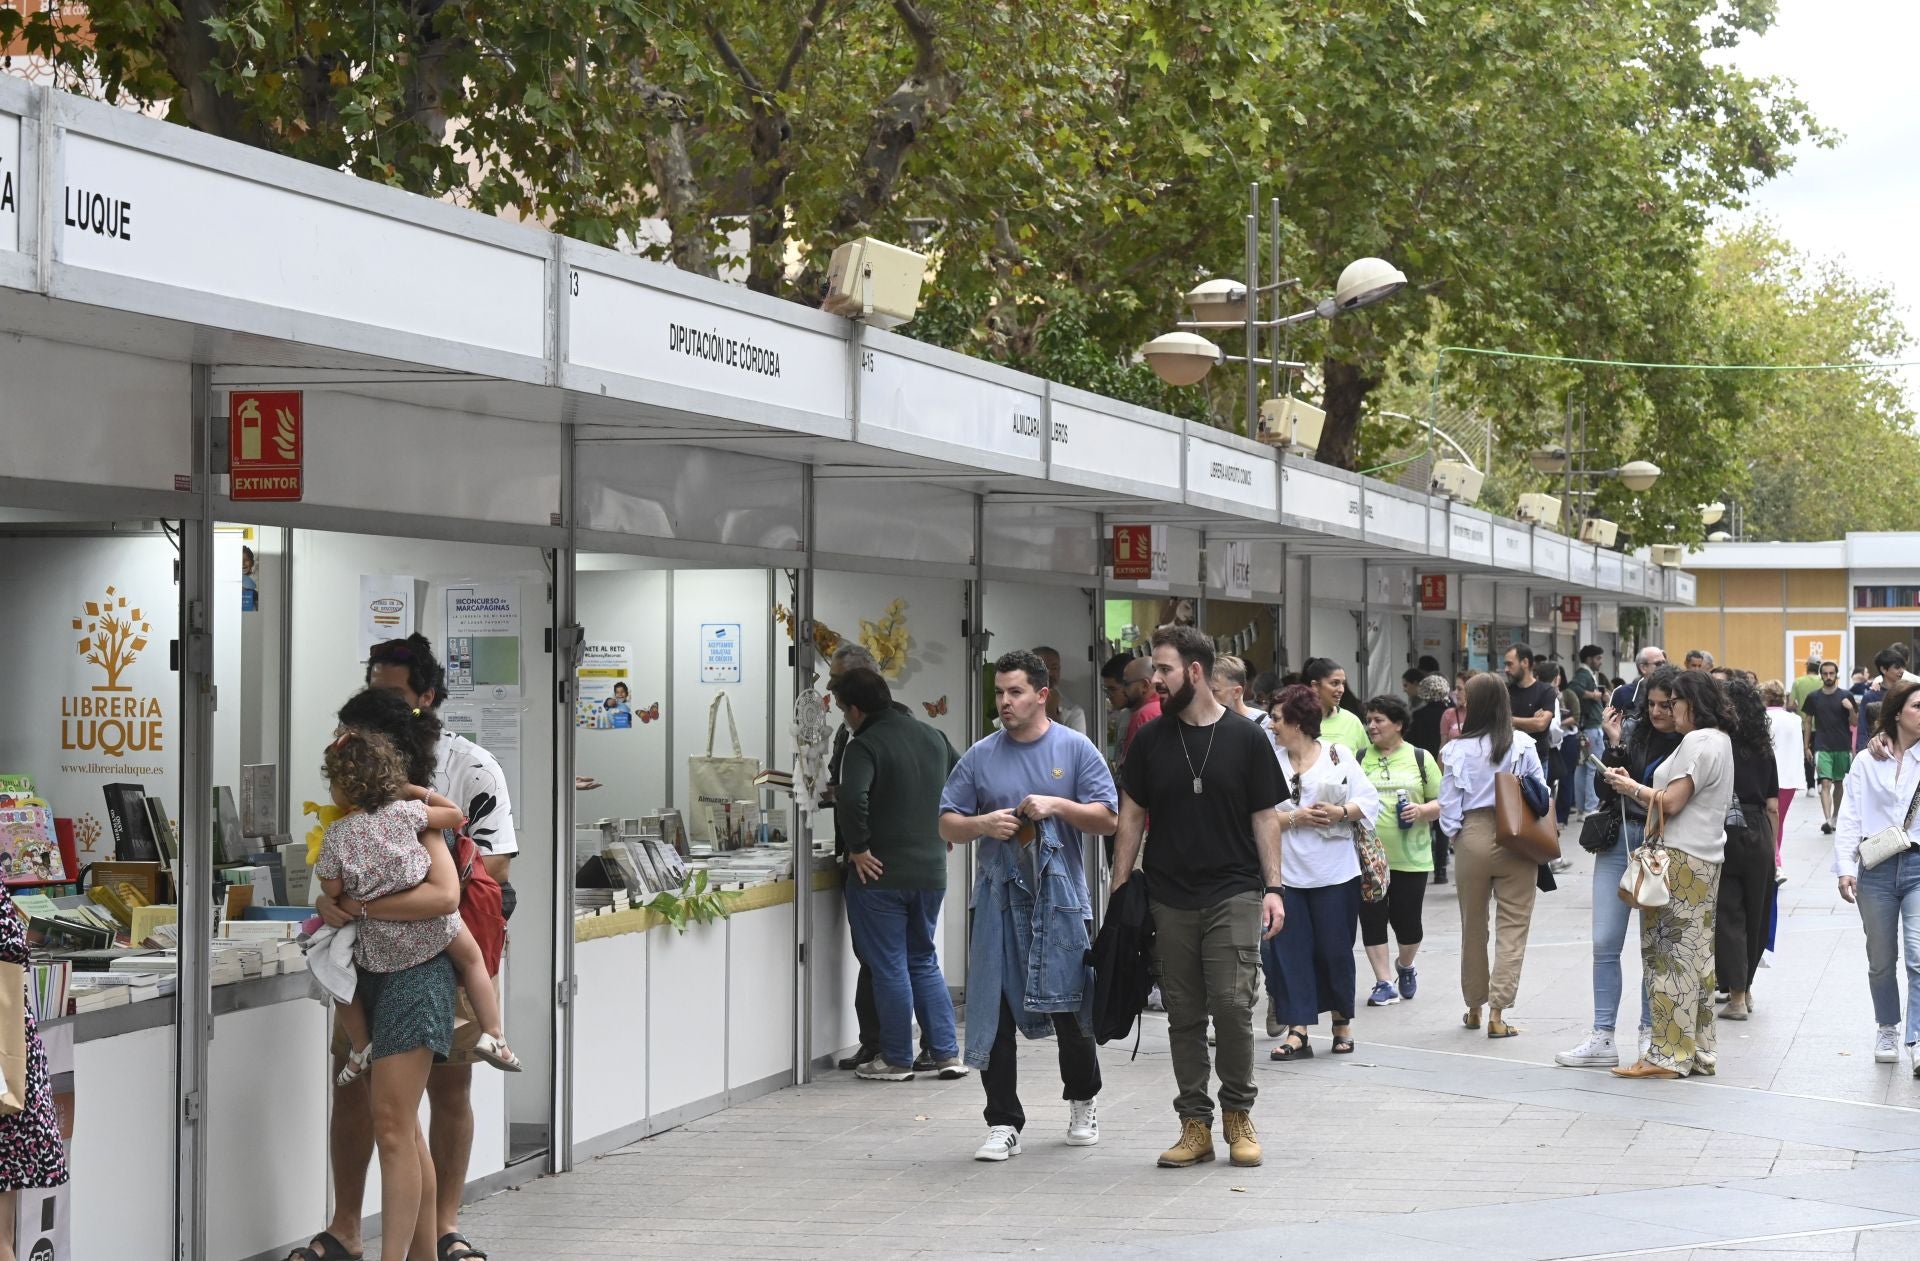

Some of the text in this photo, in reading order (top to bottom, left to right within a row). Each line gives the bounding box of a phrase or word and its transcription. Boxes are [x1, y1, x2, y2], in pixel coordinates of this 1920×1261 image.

[65, 186, 131, 241] LUQUE
[569, 271, 579, 297] 13
[669, 323, 781, 378] DIPUTACIÓN DE CÓRDOBA
[1013, 412, 1068, 445] ALMUZARA LIBROS
[235, 477, 298, 490] EXTINTOR
[61, 719, 163, 758] LUQUE
[61, 763, 164, 776] www.librerialuque.es
